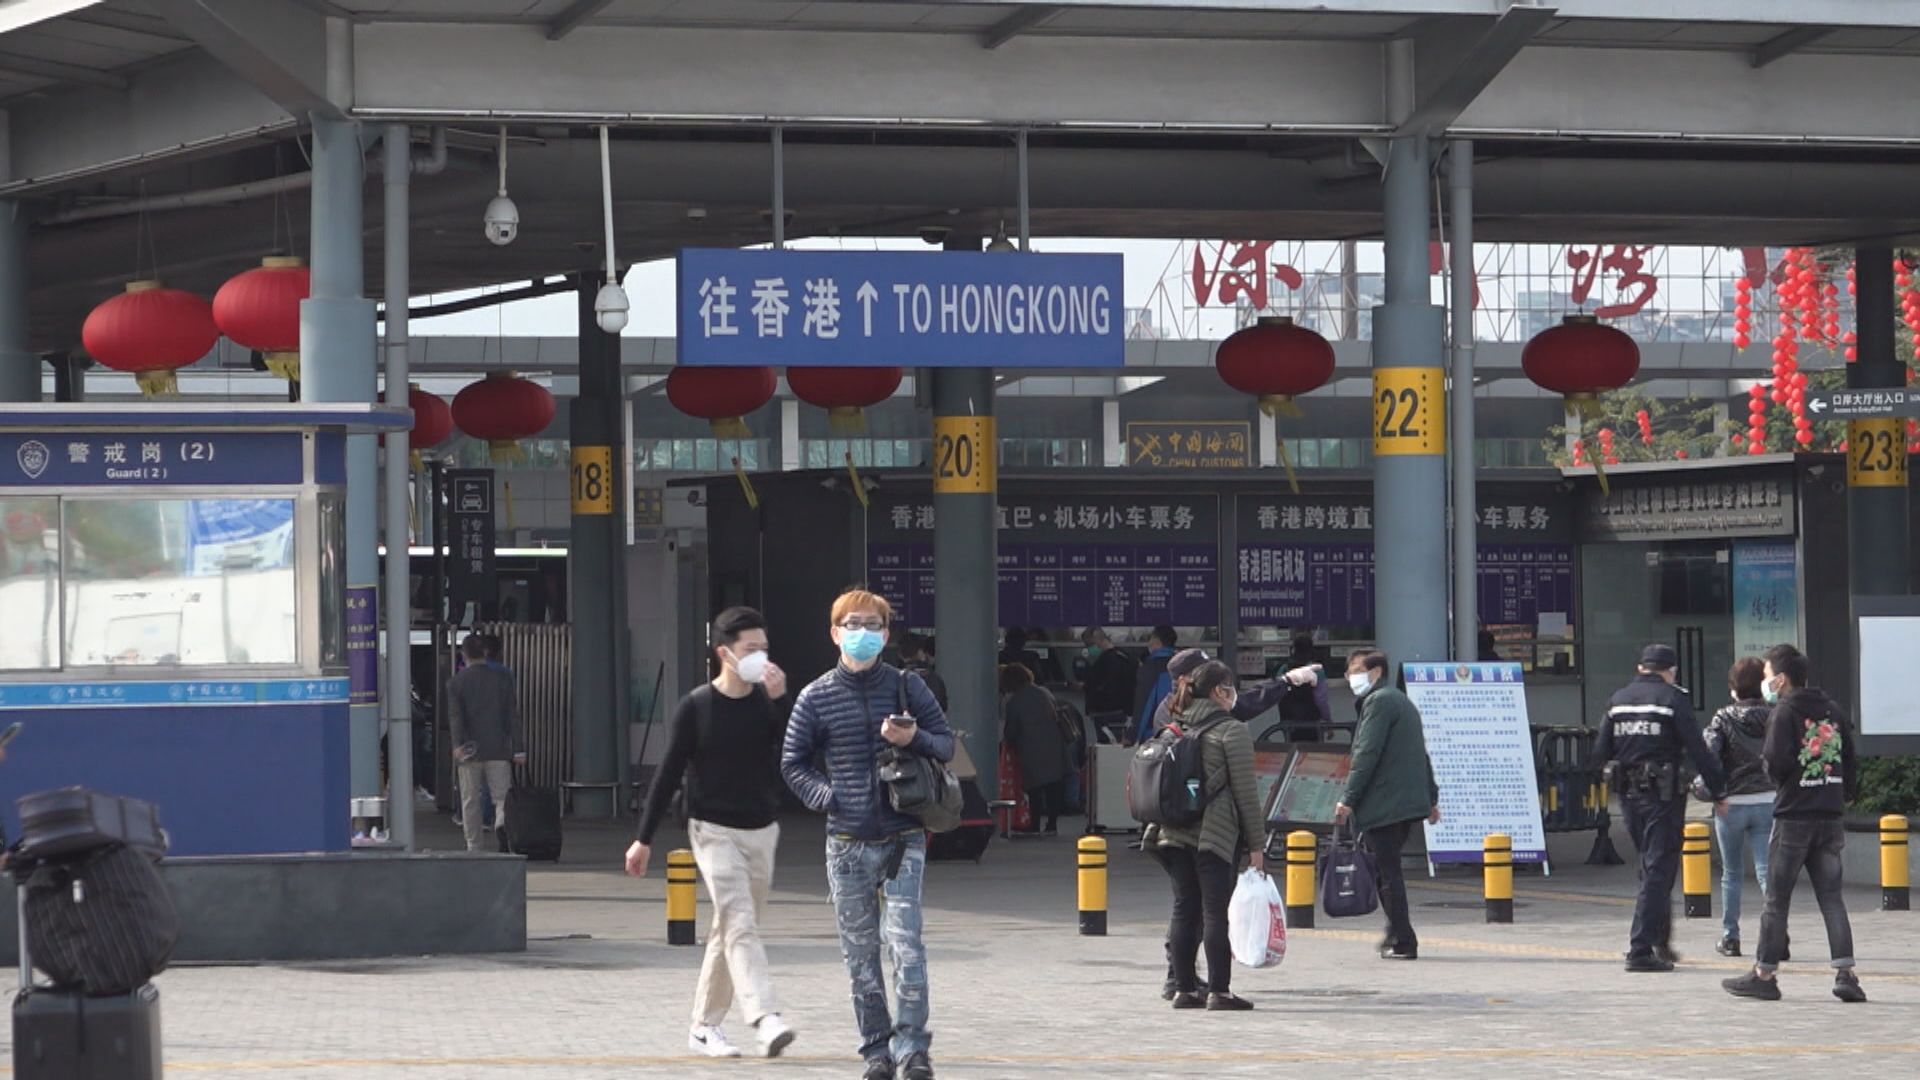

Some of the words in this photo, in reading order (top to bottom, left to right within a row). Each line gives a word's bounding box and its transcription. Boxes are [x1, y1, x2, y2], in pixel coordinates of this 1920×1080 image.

[698, 276, 841, 338] 往香港
[893, 284, 932, 334] TO
[940, 284, 1110, 335] HONGKONG
[1380, 388, 1420, 437] 22
[1832, 392, 1904, 406] 口岸大厅出入口
[68, 442, 161, 463] 警戒岗
[940, 434, 973, 478] 20
[1859, 430, 1893, 471] 23
[575, 462, 602, 501] 18
[1239, 549, 1305, 583] 香港国际机场
